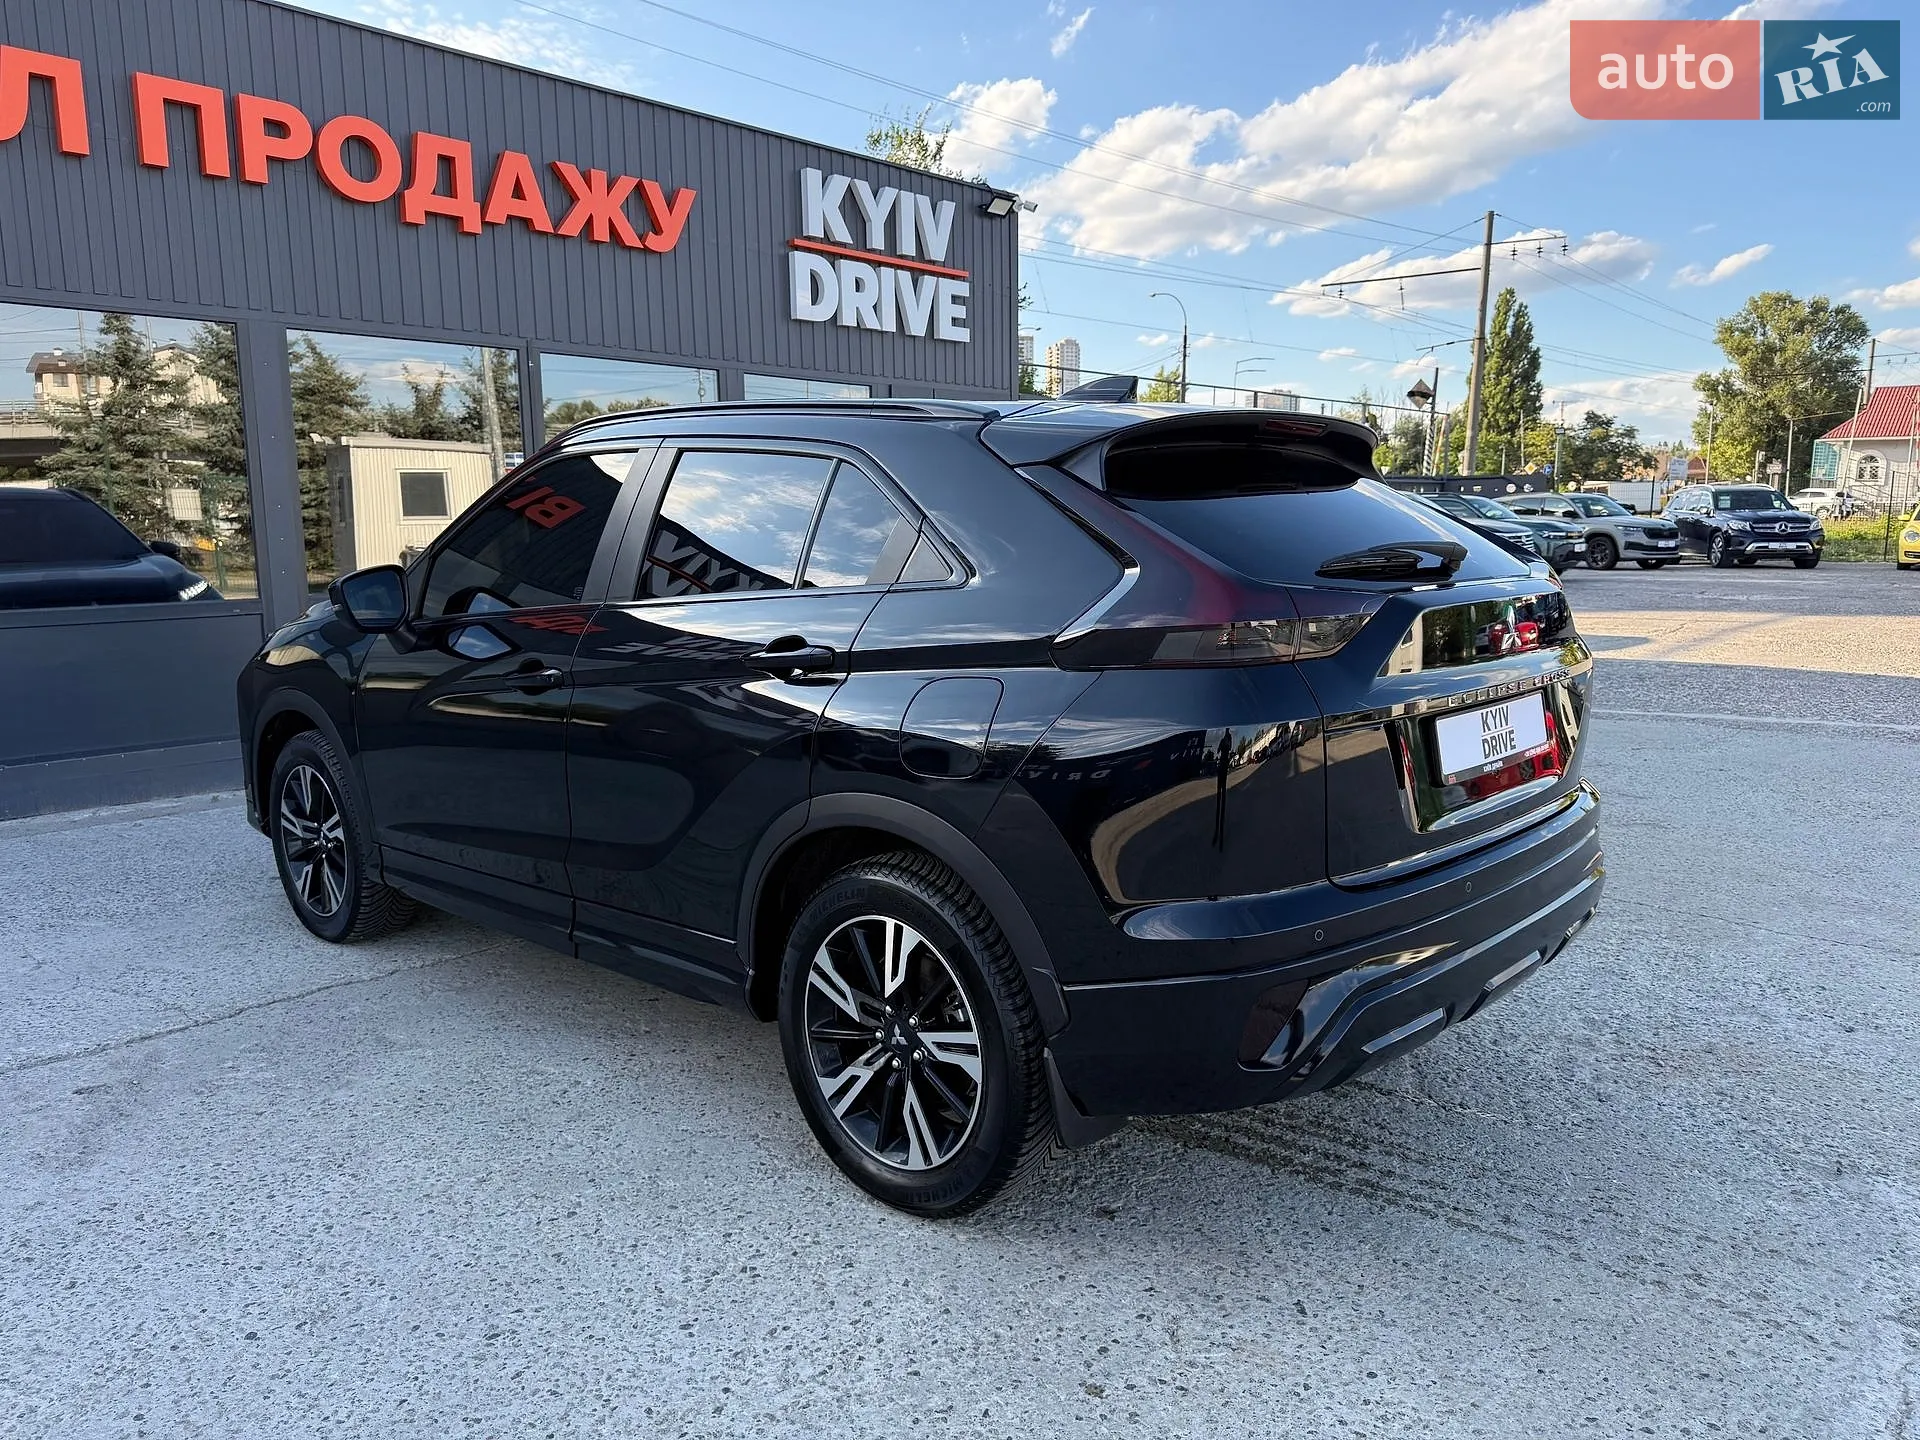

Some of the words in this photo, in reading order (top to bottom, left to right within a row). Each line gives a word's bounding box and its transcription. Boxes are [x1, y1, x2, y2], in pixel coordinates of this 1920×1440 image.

[132, 71, 697, 253] ПРОДАЖУ
[800, 167, 956, 262] KYIV
[788, 250, 970, 343] DRIVE
[1480, 704, 1509, 734] KYIV
[1481, 729, 1517, 760] DRIVE
